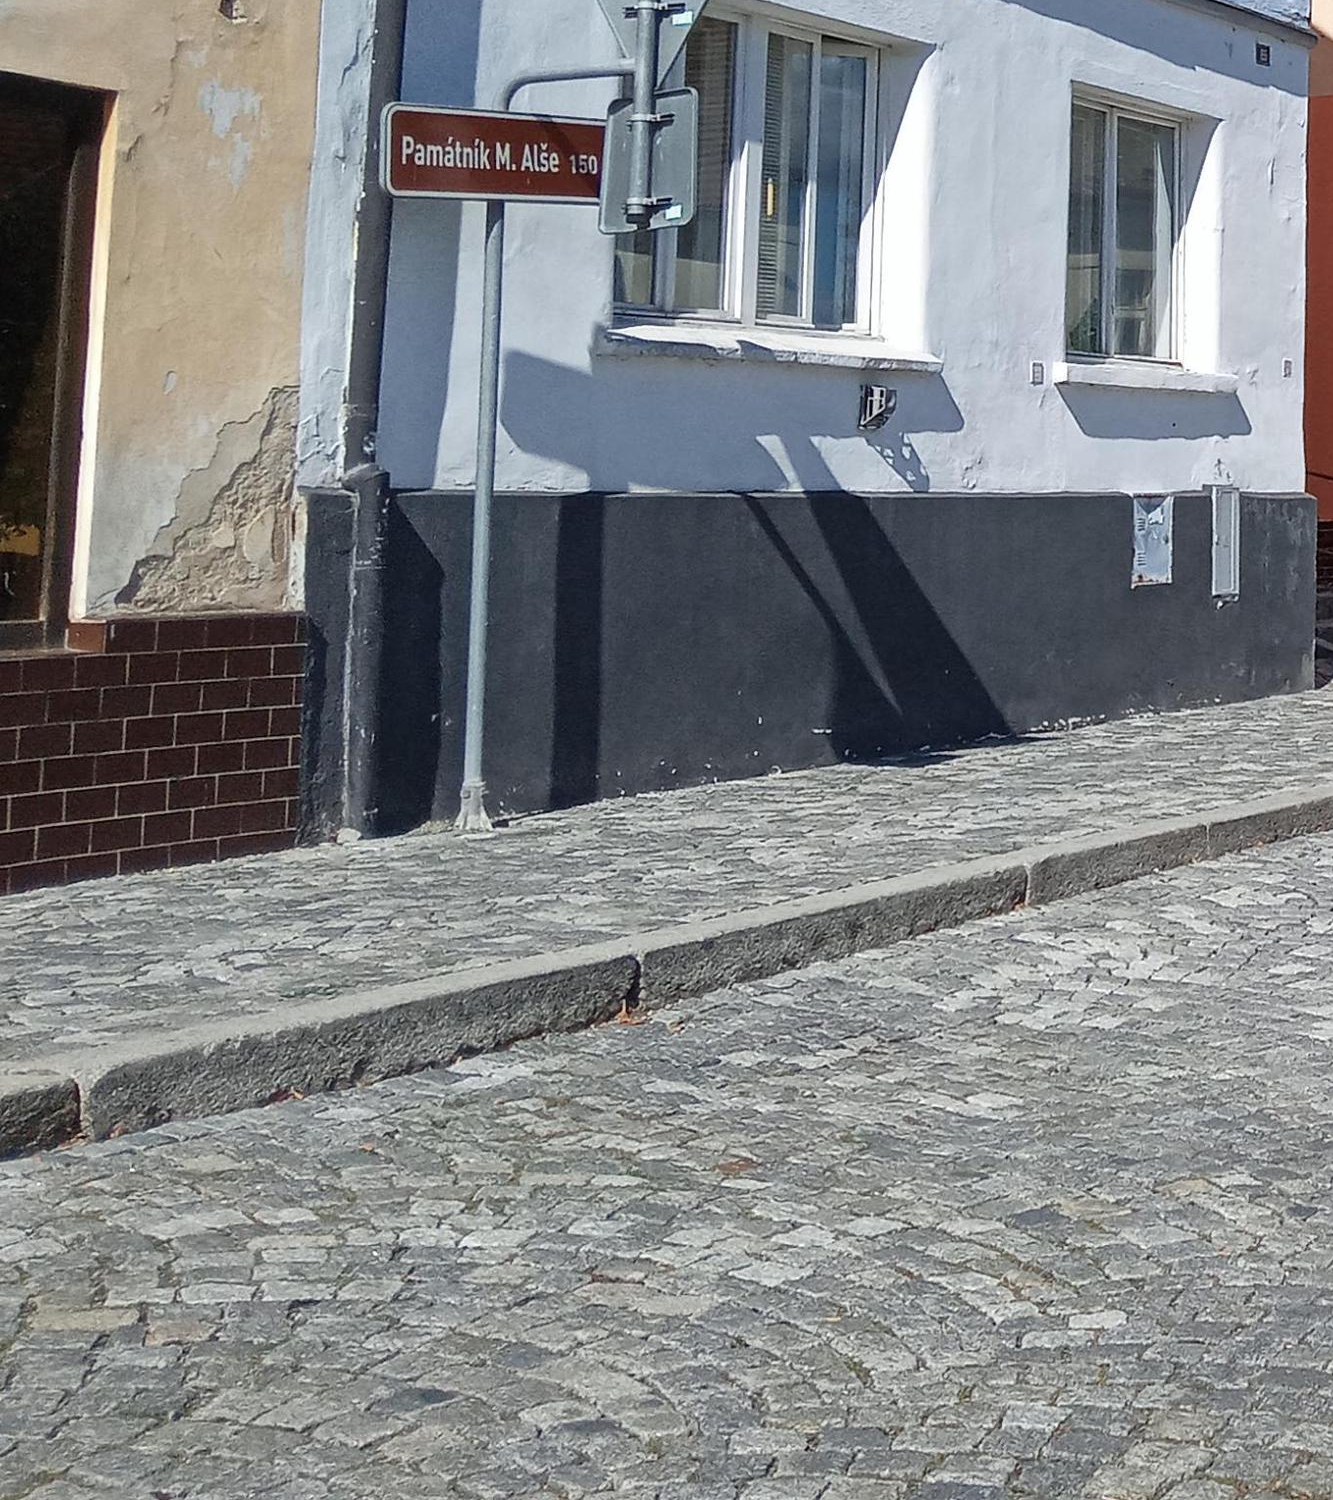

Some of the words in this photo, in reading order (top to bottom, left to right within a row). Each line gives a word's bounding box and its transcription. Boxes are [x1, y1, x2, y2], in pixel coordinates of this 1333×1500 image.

[401, 135, 491, 170] Památník
[496, 142, 517, 171] M.
[521, 143, 560, 173] Alše
[569, 154, 598, 175] 150
